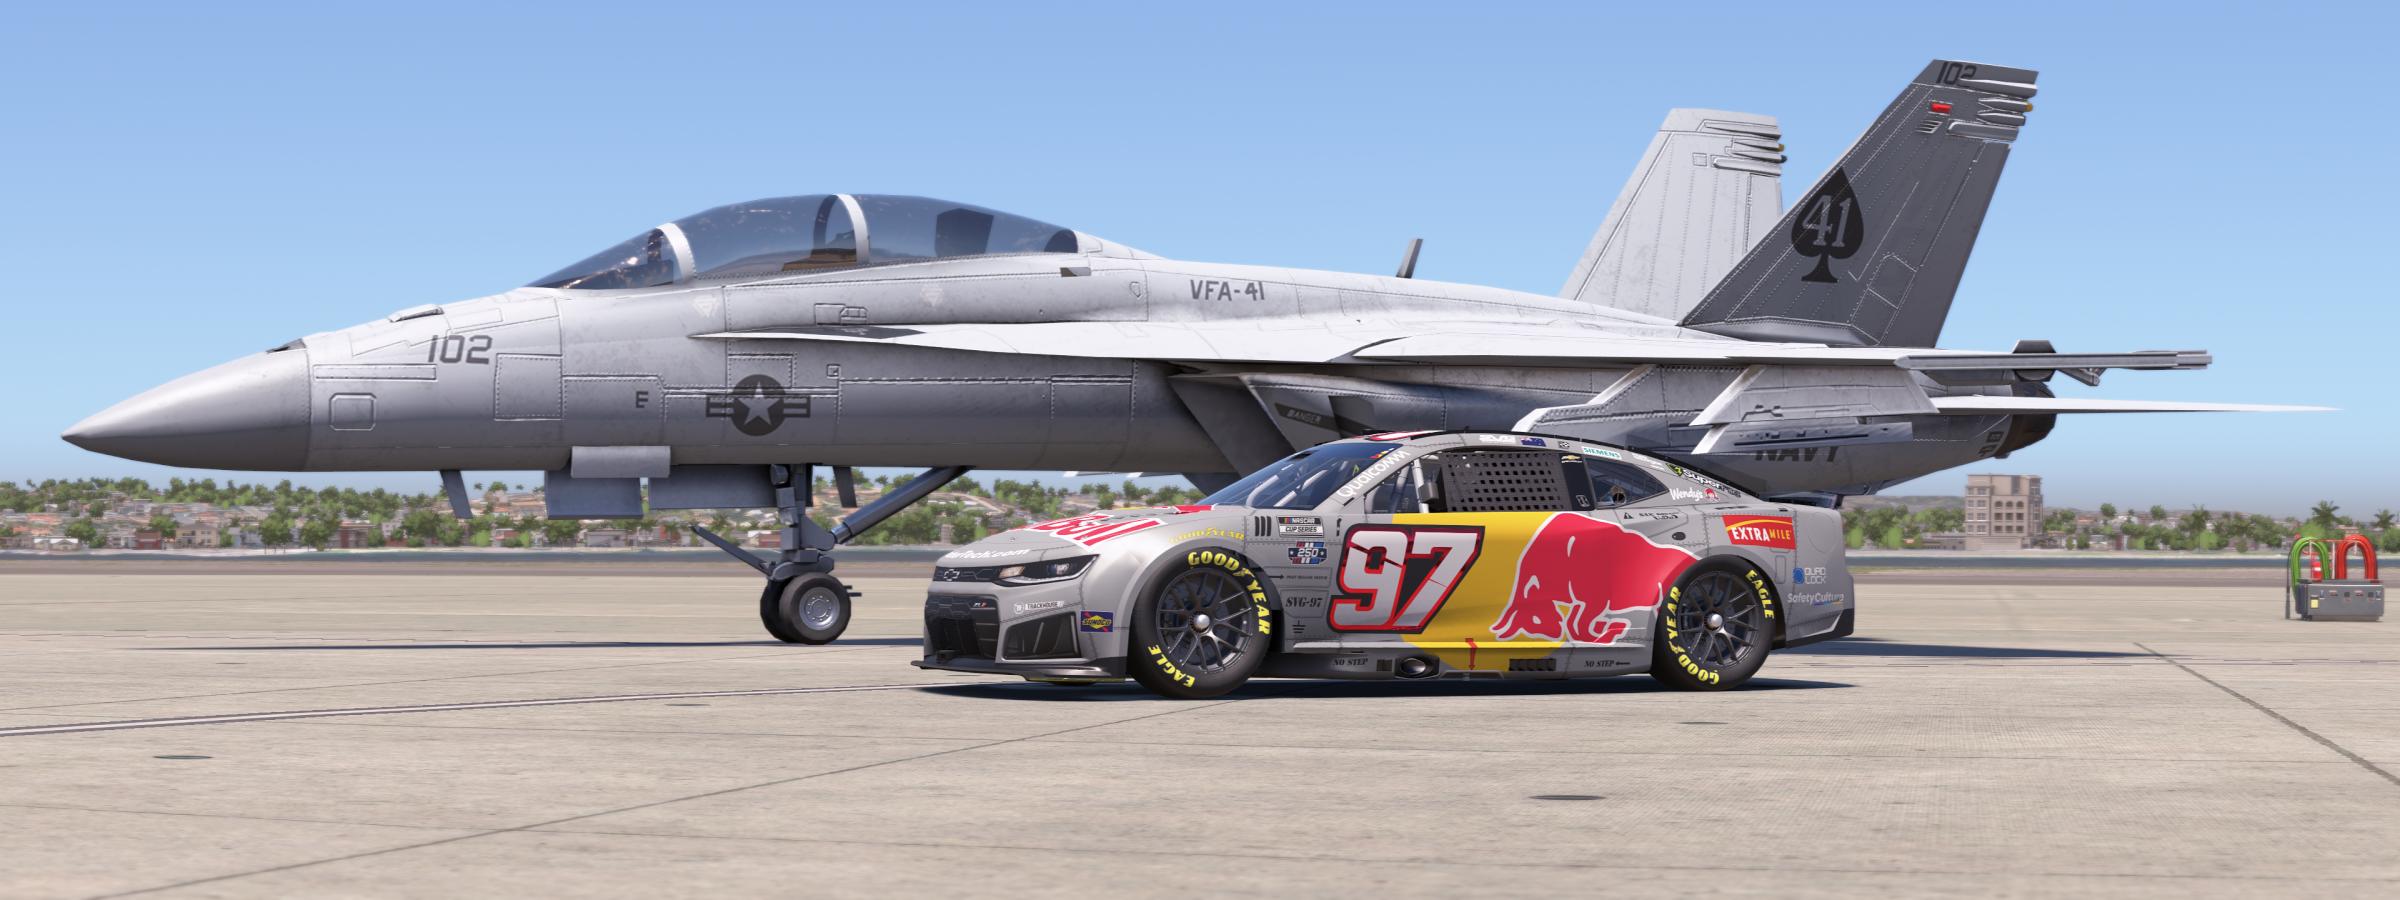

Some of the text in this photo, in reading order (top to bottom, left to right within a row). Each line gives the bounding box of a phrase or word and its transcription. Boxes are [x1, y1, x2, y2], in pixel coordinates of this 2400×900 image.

[1936, 61, 1977, 85] 102
[1802, 195, 1852, 248] 41
[1190, 279, 1265, 302] VFA-41
[427, 334, 493, 365] 102
[1583, 447, 1621, 459] SIEMENS
[1337, 449, 1411, 498] Qualcomm
[1297, 548, 1319, 558] 250
[1327, 523, 1485, 634] 97
[1026, 601, 1059, 610] TRACKHOUSE
[1187, 551, 1272, 635] GOODYEAR
[1745, 569, 1775, 620] EAGLE
[1787, 592, 1845, 605] SafetyCulture
[1082, 617, 1112, 627] SUNOCO
[1666, 586, 1720, 685] GOODYEAR
[1147, 644, 1196, 688] EAGLE
[1333, 658, 1369, 666] NO STEP
